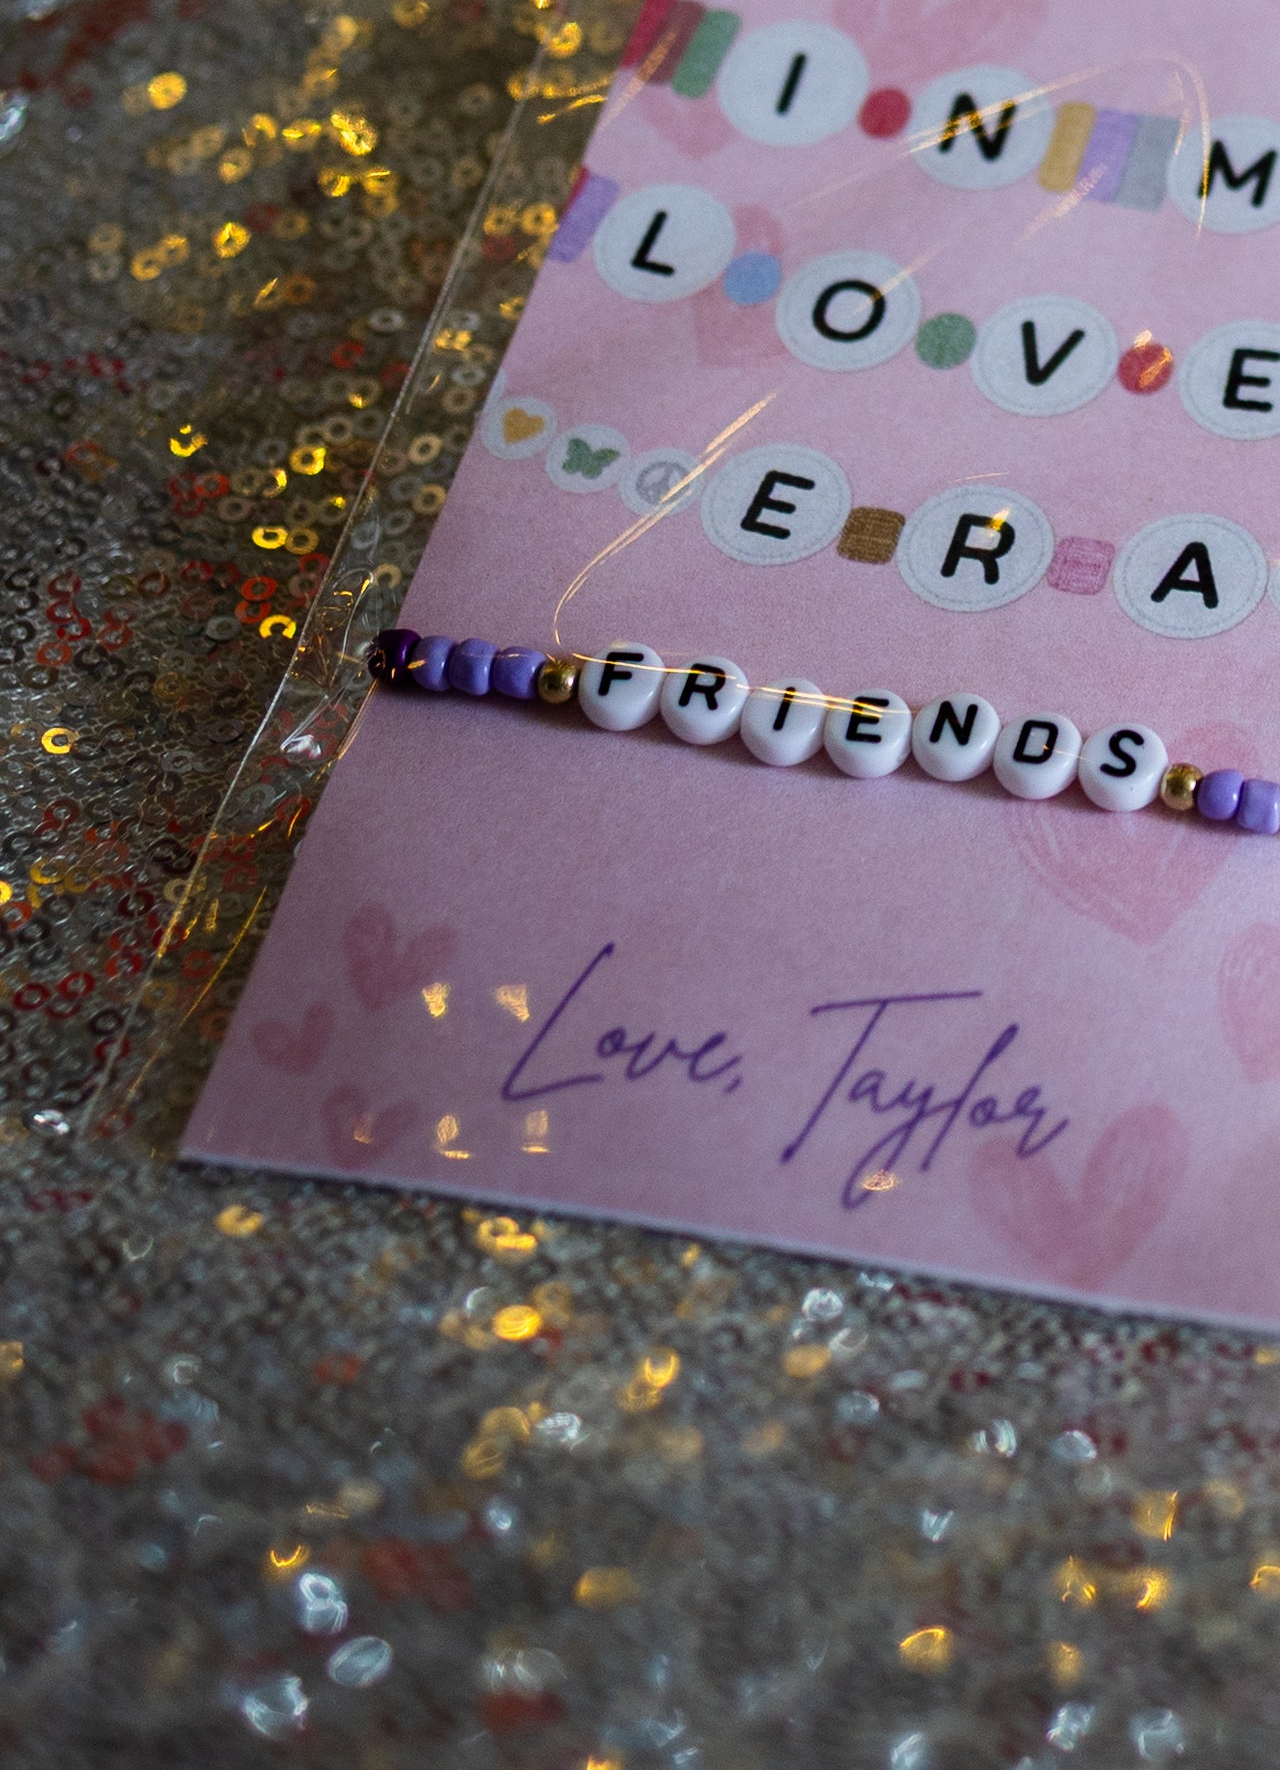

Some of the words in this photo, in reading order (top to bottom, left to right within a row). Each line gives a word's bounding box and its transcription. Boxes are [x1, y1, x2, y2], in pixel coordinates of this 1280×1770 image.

[775, 50, 1021, 165] IN
[736, 468, 1226, 612] ERA
[596, 650, 1148, 780] FRIENDS
[501, 942, 743, 1103] Love,
[780, 990, 1070, 1211] Taylor
